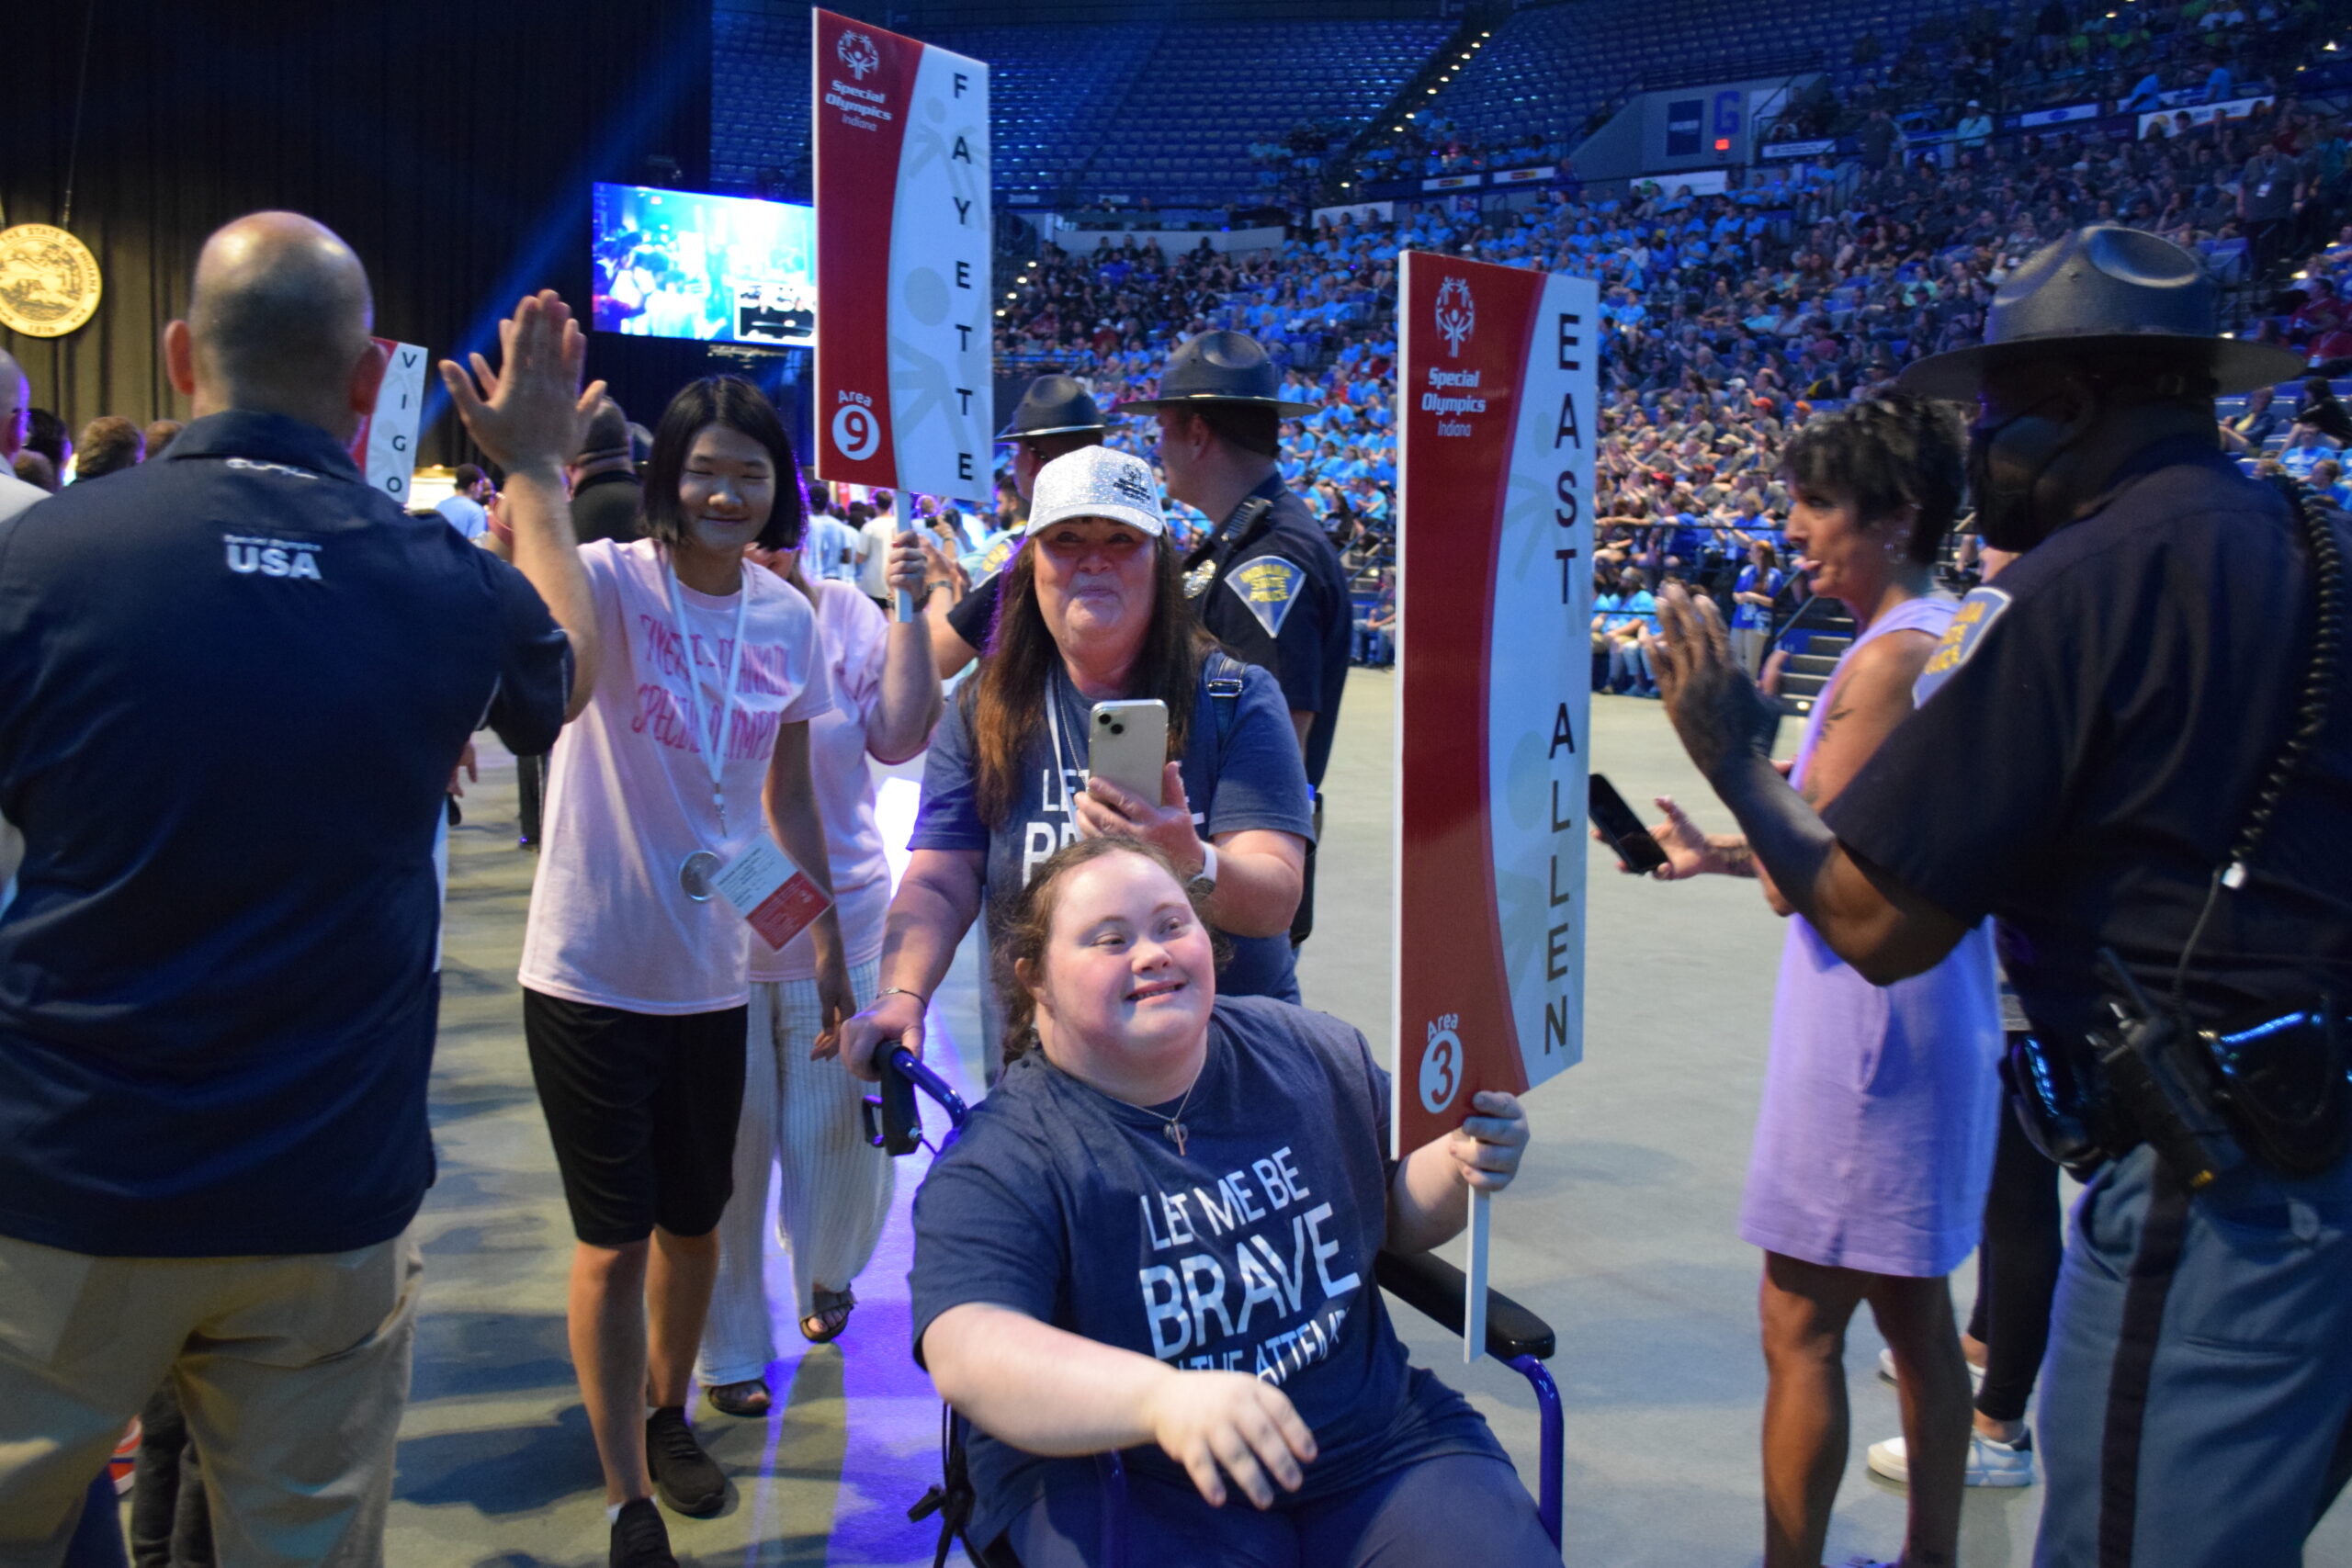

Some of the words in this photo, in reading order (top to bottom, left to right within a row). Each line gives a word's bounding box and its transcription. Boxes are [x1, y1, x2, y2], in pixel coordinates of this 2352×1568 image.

[825, 93, 892, 121] Olympics
[831, 79, 886, 104] Special
[842, 114, 877, 131] Indiana
[952, 73, 973, 480] FAYETTE
[1428, 367, 1480, 389] Special
[838, 389, 873, 407] Area
[1421, 392, 1486, 415] Olympics
[387, 352, 417, 493] VIGO
[843, 411, 869, 452] 9
[1437, 420, 1472, 437] Indiana
[1555, 312, 1581, 604] EAST
[227, 544, 322, 580] USA
[1544, 702, 1576, 1055] ALLEN
[1428, 1012, 1459, 1041] Area
[1430, 1039, 1453, 1106] 3
[1140, 1191, 1194, 1251] LET
[1193, 1170, 1266, 1236] ME
[1252, 1146, 1310, 1211] BE
[1139, 1201, 1362, 1360] BRAVE
